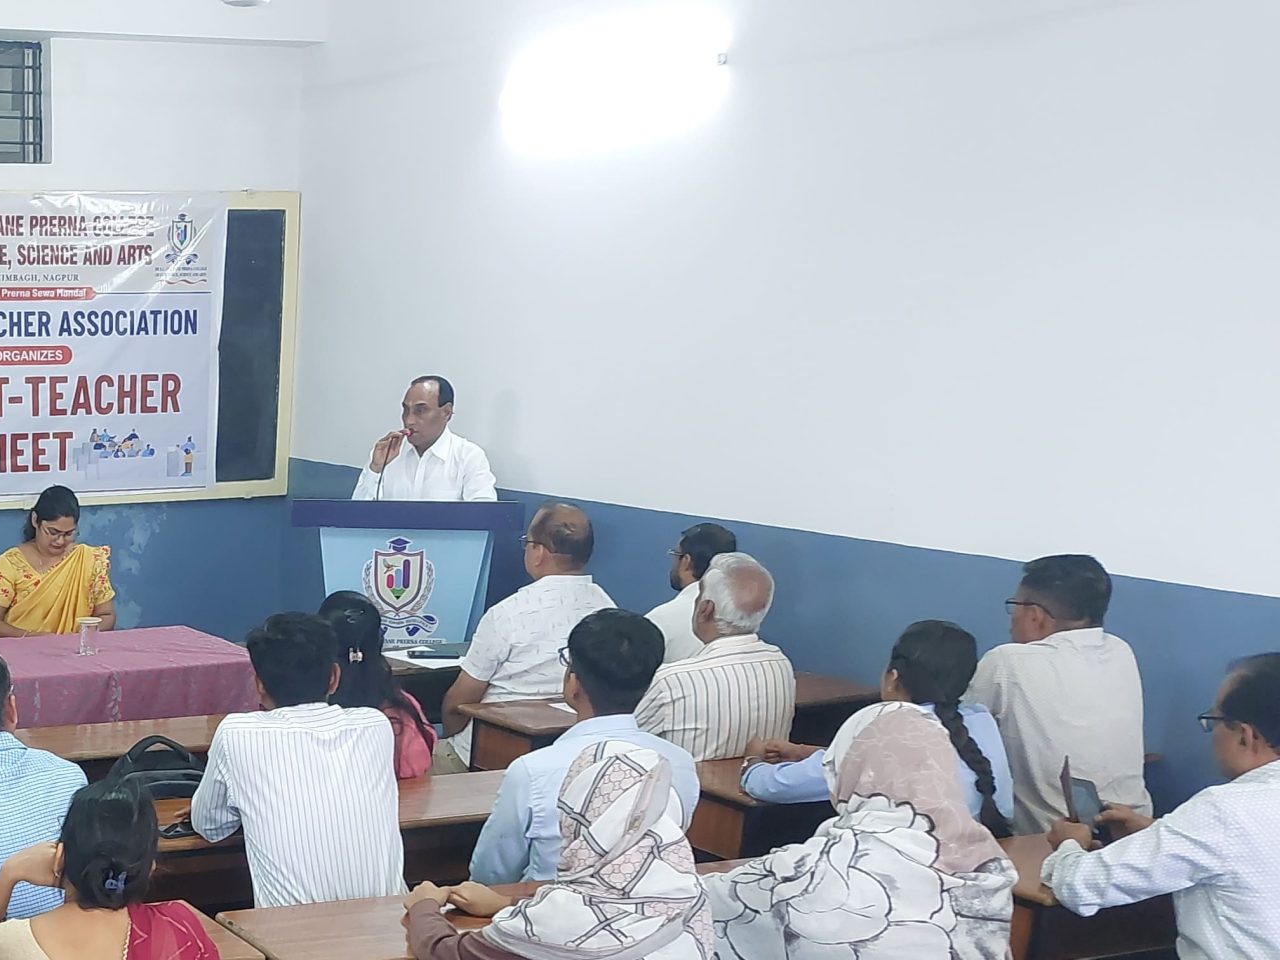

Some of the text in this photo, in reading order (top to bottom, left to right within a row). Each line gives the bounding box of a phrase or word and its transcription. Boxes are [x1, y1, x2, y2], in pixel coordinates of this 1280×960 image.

[29, 215, 89, 237] PRERNA
[17, 244, 78, 266] SCIENCE
[82, 245, 113, 266] AND
[116, 245, 153, 266] ARTS
[43, 273, 80, 282] NAGPUR
[1, 288, 31, 298] Prerna
[32, 288, 55, 298] Sewa
[58, 309, 198, 337] ASSOCIATION
